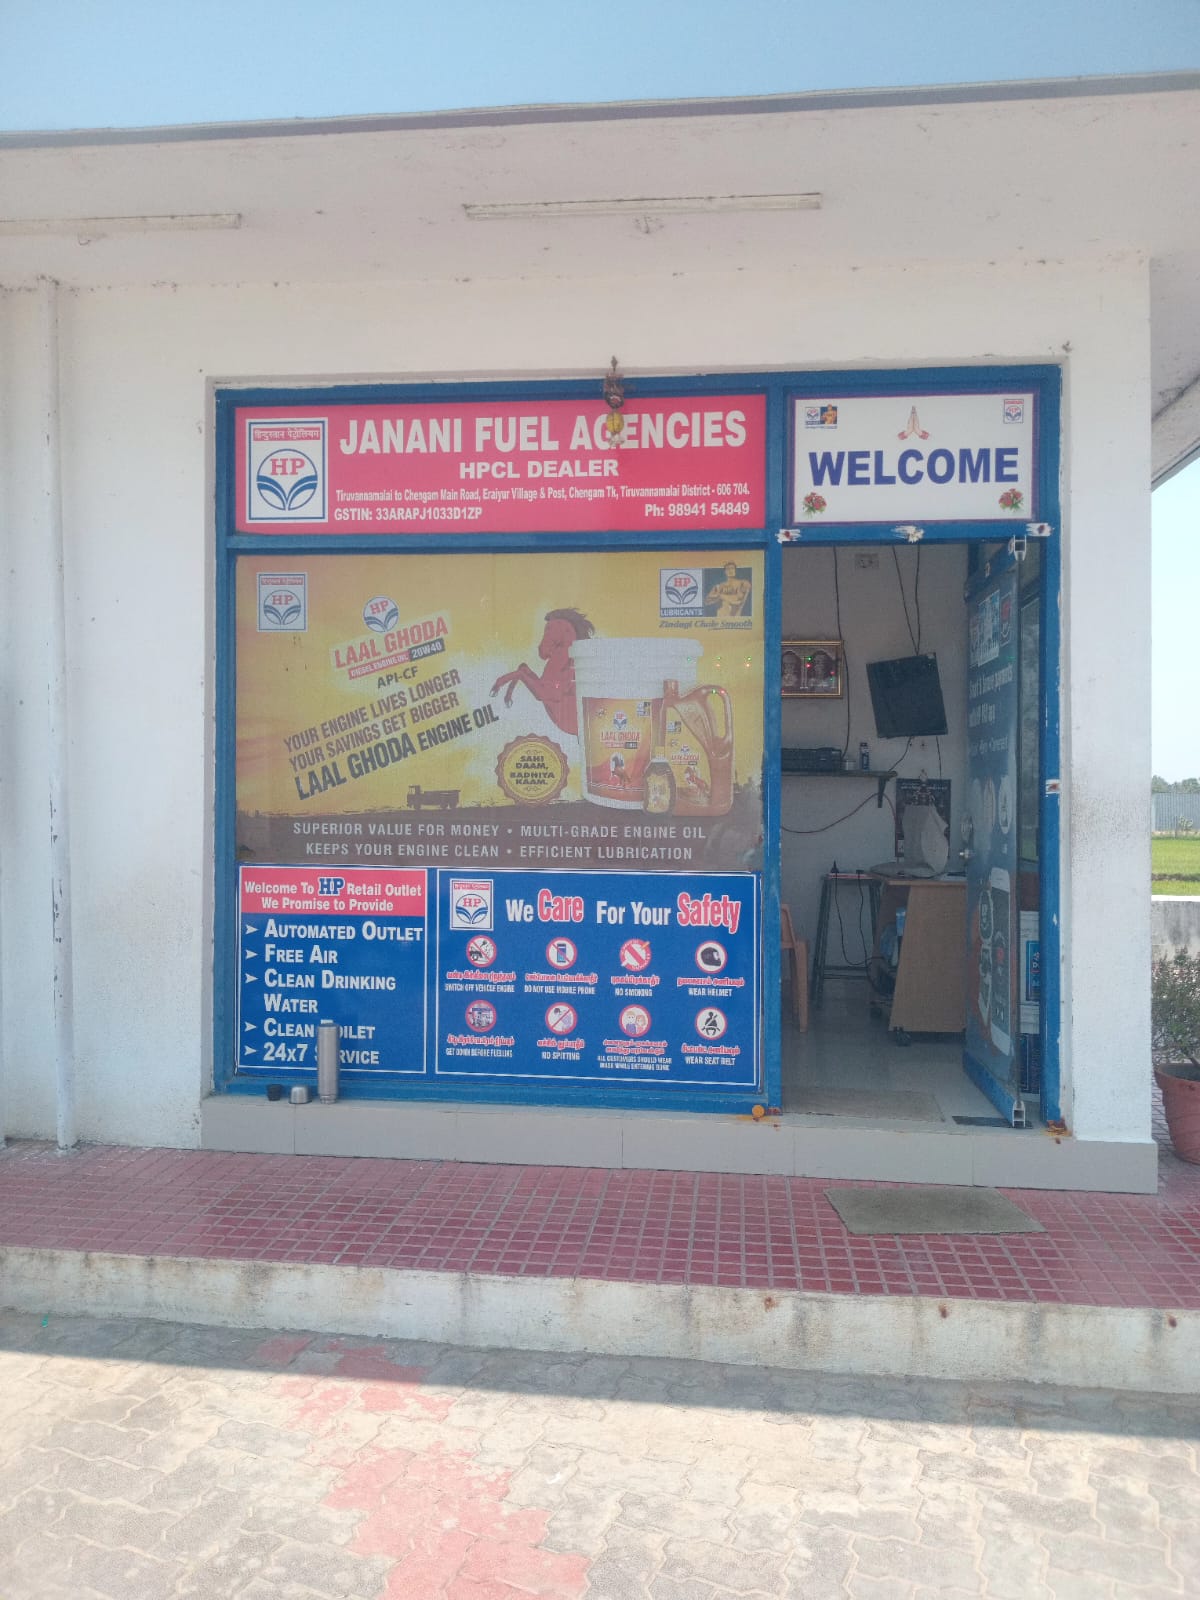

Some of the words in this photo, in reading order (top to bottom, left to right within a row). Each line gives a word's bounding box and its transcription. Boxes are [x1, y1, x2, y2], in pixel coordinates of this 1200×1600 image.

[340, 418, 462, 454] JANANI
[475, 416, 559, 452] FUEL
[270, 457, 305, 475] HP
[460, 462, 520, 479] HPCL
[528, 459, 619, 478] DEALER
[808, 448, 1018, 486] WELCOME
[336, 490, 392, 502] Tiruvannamalai
[394, 490, 402, 501] to
[404, 488, 438, 503] Chengam
[440, 488, 458, 500] Main
[460, 488, 480, 502] Road,
[511, 488, 538, 502] Village
[540, 487, 546, 499] &
[548, 486, 567, 501] Post,
[568, 486, 604, 501] Chengam
[620, 484, 680, 497] Tiruvannamalai
[682, 484, 711, 497] District
[717, 483, 732, 496] 606
[334, 508, 373, 521] GSTIN:
[645, 504, 664, 517] Ph:
[668, 503, 706, 516] 98941
[711, 502, 750, 516] 54849
[674, 577, 692, 588] HP
[272, 594, 294, 605] HP
[370, 600, 390, 614] HP
[660, 608, 703, 617] LUBRICANTS
[335, 638, 382, 668] LAAL
[384, 616, 448, 654] GHODA
[411, 642, 442, 658] 20W40
[377, 666, 418, 689] API-CF
[283, 727, 319, 753] YOUR
[320, 706, 369, 740] ENGINE
[370, 691, 408, 718] LIVES
[408, 668, 462, 702] LONGER
[289, 746, 326, 773] YOUR
[326, 723, 381, 758] SAVINGS
[382, 712, 409, 736] GET
[410, 692, 460, 724] BIGGER
[294, 762, 348, 801] LAAL
[347, 732, 417, 780] GHODA
[417, 714, 473, 751] ENGINE
[473, 704, 500, 728] OIL
[293, 822, 362, 835] SUPERIOR
[368, 823, 412, 836] VALUE
[418, 824, 445, 836] FOR
[450, 824, 500, 837] MONEY
[520, 825, 618, 838] MULTI-GRADE
[624, 826, 676, 839] ENGINE
[682, 826, 706, 839] OIL
[306, 842, 349, 856] KEEPS
[356, 844, 392, 856] YOUR
[398, 844, 449, 857] ENGINE
[454, 844, 499, 858] CLEAN
[520, 846, 592, 858] EFFICIENT
[598, 846, 692, 860] LUBRICATION
[244, 881, 297, 894] Welcome
[301, 882, 314, 894] To
[318, 876, 345, 896] HP
[347, 883, 382, 896] Retail
[386, 884, 422, 897] Outlet
[262, 897, 279, 910] We
[282, 898, 330, 910] Promise
[334, 899, 346, 911] to
[349, 898, 394, 912] Provide
[462, 898, 482, 908] HP
[506, 899, 534, 922] We
[538, 888, 584, 922] Care
[596, 900, 626, 924] For
[630, 901, 672, 926] Your
[677, 891, 742, 934] Safety
[524, 984, 532, 992] DO
[532, 985, 544, 993] NOT
[544, 986, 556, 994] USE
[556, 986, 576, 994] MOBILE
[577, 986, 596, 994] PHONE
[614, 988, 624, 996] NO
[624, 988, 653, 997] SMOKING
[688, 988, 706, 996] WEAR
[707, 988, 732, 997] HELMET
[264, 1042, 308, 1062] 24x7
[542, 1051, 551, 1060] NO
[552, 1052, 580, 1061] SPITTING
[685, 1056, 704, 1064] WEAR
[704, 1056, 720, 1065] SEAT
[720, 1057, 736, 1066] BELT
